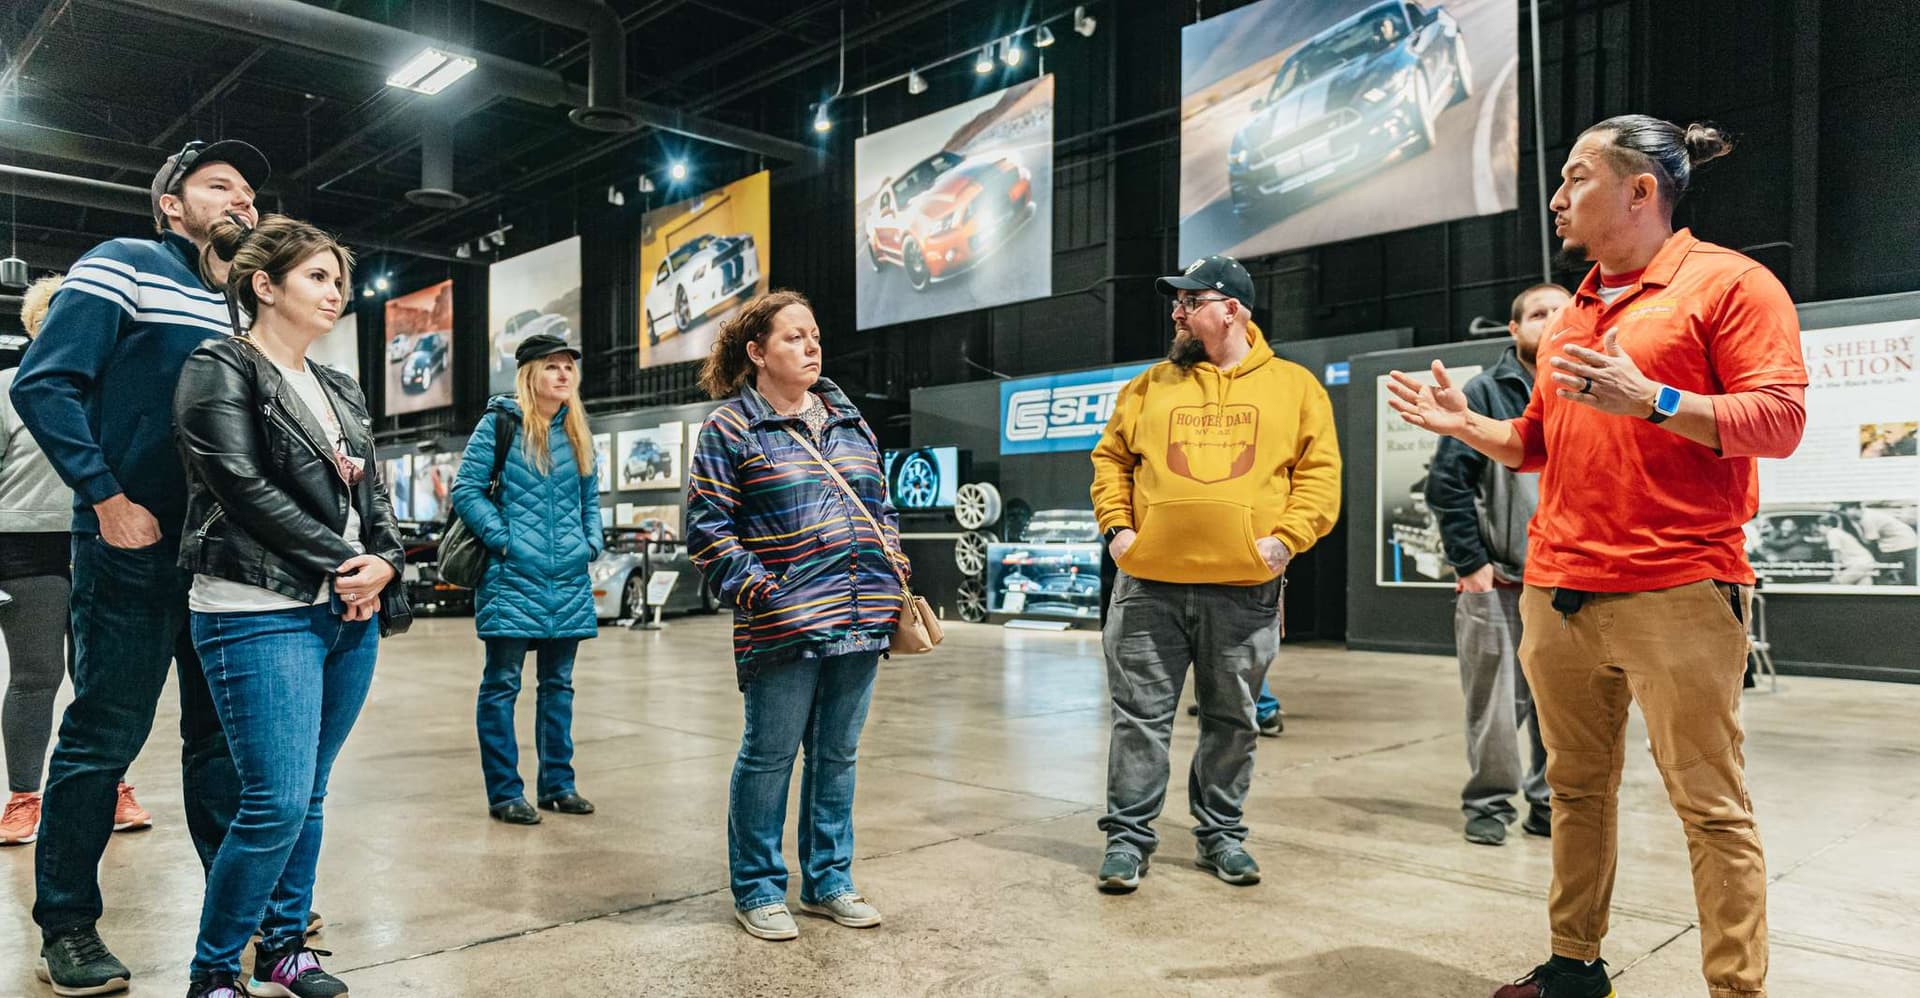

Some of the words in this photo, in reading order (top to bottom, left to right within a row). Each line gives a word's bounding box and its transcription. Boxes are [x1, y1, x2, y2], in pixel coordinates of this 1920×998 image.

[1823, 335, 1914, 358] SHELBY
[1176, 413, 1223, 427] HOOVER
[1225, 412, 1251, 427] DAM
